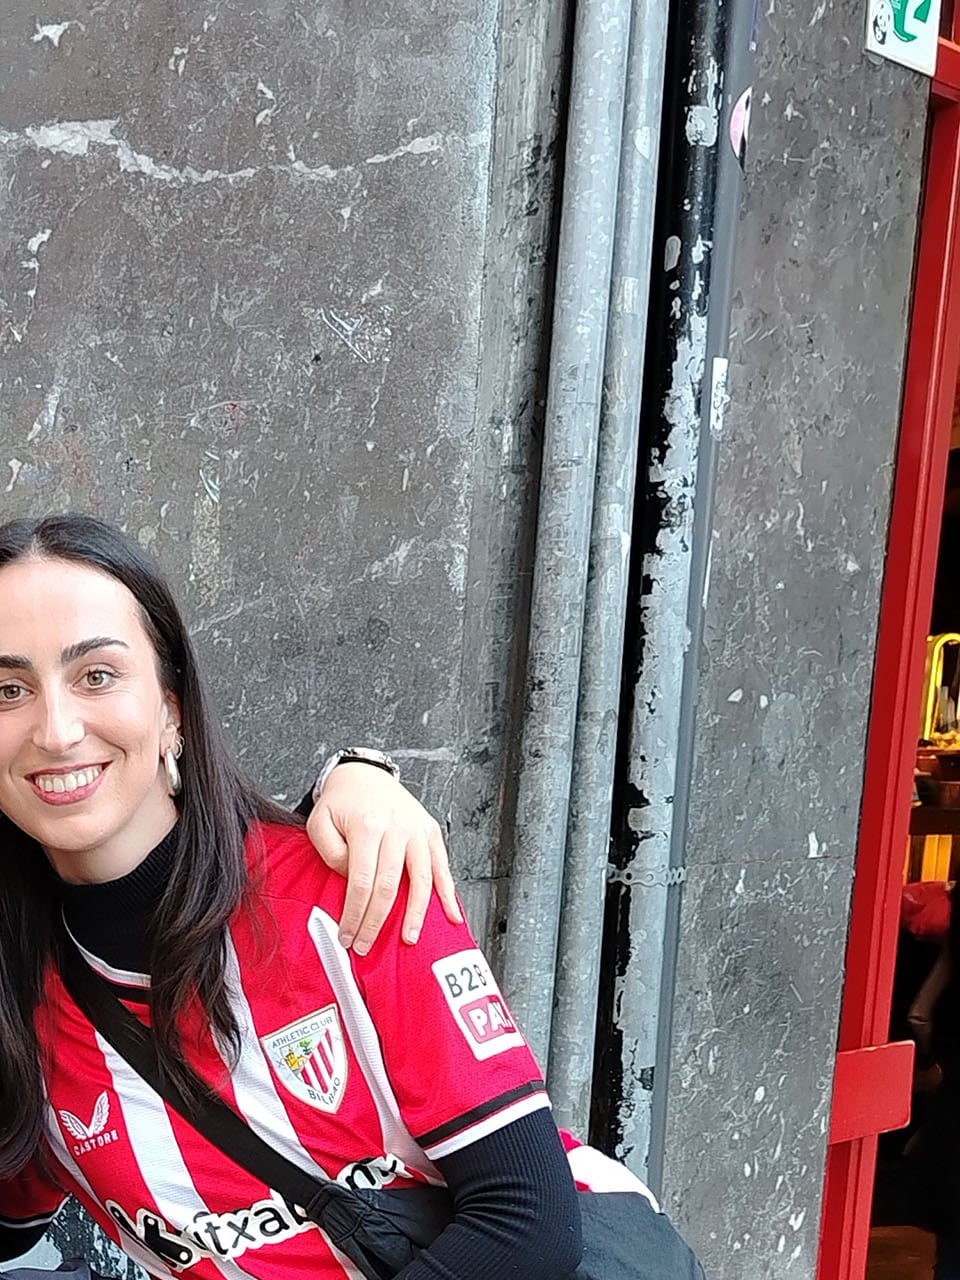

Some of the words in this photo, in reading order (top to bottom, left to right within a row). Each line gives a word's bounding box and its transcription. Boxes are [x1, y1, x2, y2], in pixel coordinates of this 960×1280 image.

[272, 1025, 309, 1049] ATHLETIC
[307, 1077, 341, 1105] BILBAO
[73, 1129, 119, 1156] CASTORE
